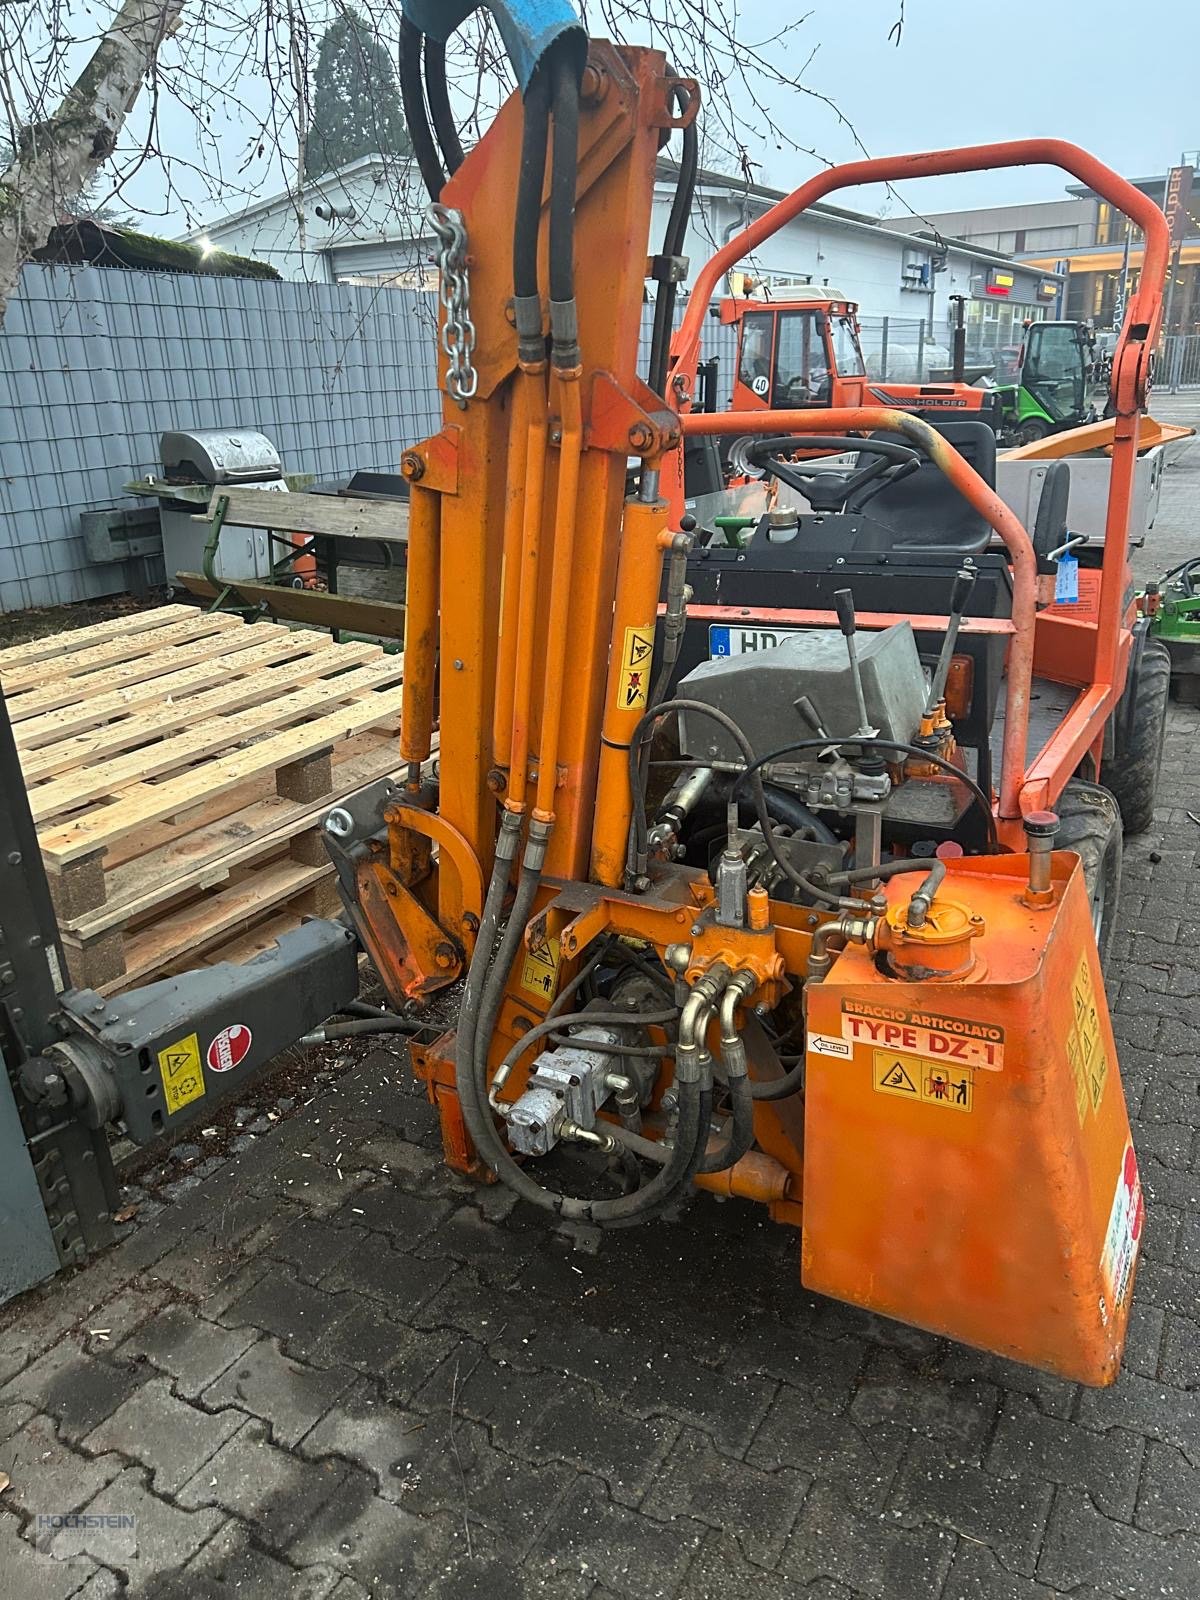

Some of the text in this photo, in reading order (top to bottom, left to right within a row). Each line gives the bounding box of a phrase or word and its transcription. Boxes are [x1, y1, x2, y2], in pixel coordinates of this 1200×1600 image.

[755, 379, 766, 391] 40
[916, 399, 966, 407] HOLDER
[718, 645, 725, 654] D
[844, 1001, 1001, 1040] BRACCIO ARTICOLATO
[848, 1017, 996, 1066] TYPE DZ-1
[829, 1044, 845, 1052] LEVEL
